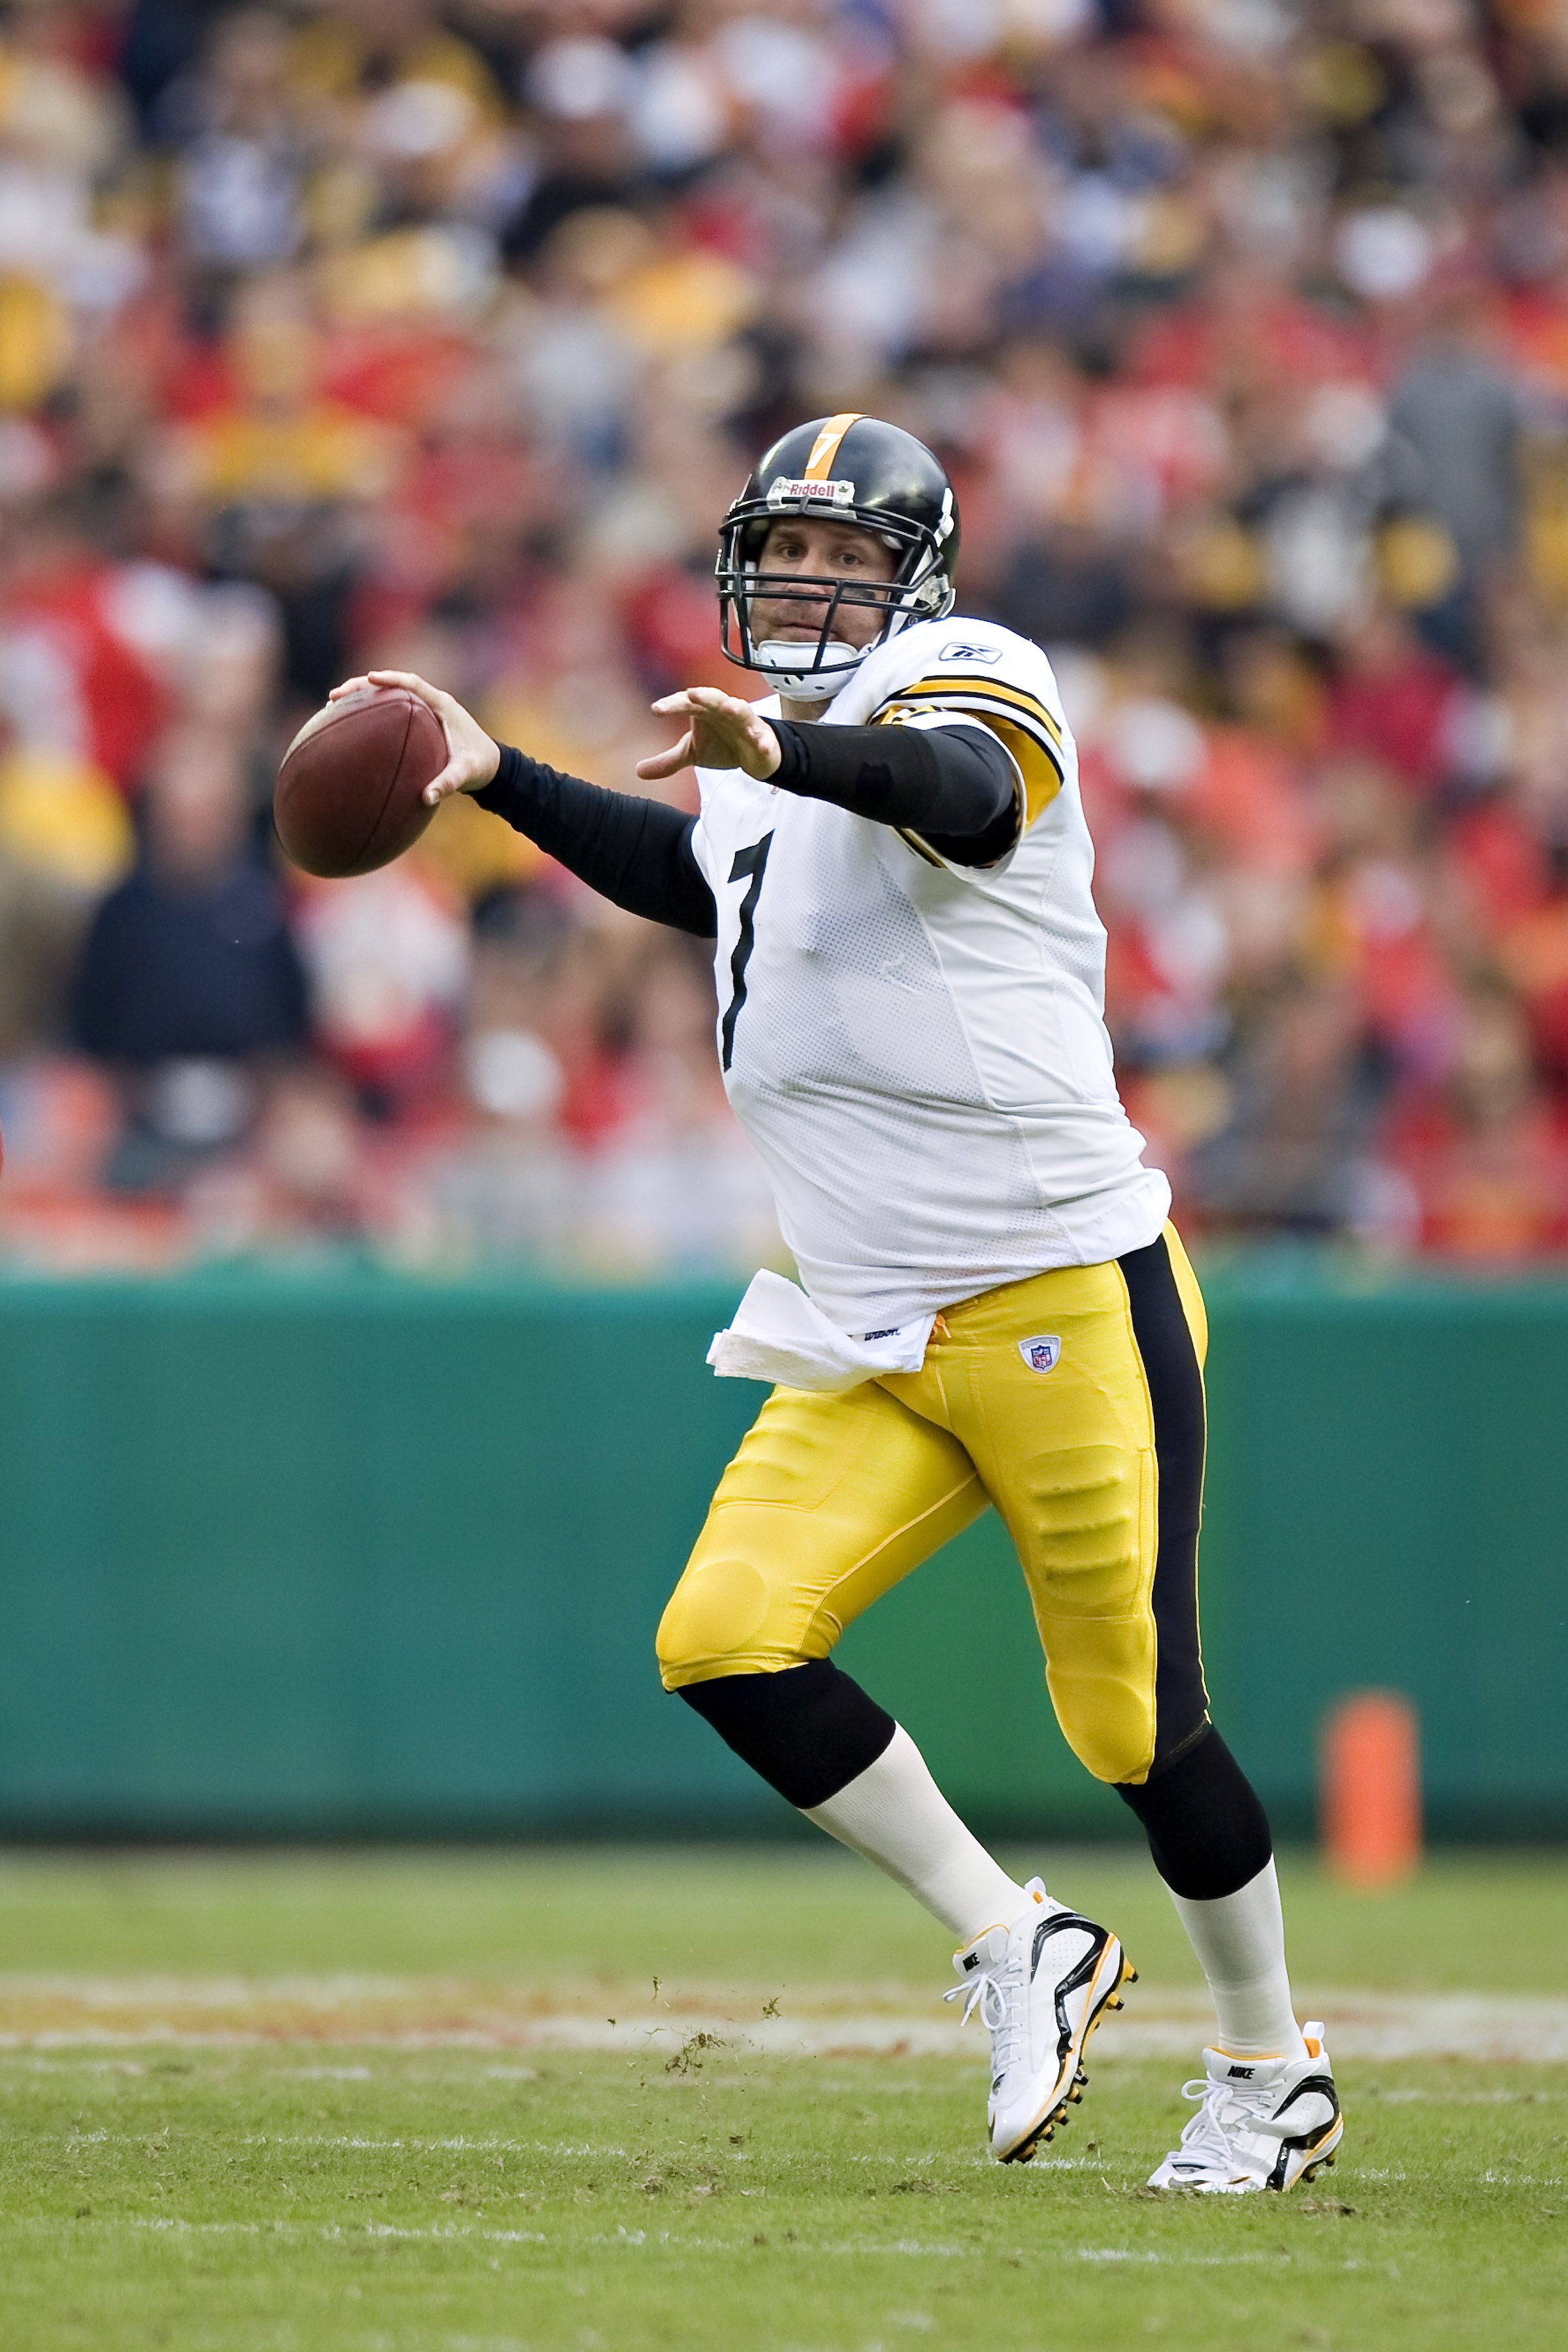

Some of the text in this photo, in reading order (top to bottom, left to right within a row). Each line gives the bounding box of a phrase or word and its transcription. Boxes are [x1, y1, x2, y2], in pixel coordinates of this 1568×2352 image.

[805, 433, 843, 470] 7
[789, 483, 835, 497] Riddell
[722, 828, 776, 1073] 7
[1227, 2065, 1256, 2080] NIKE
